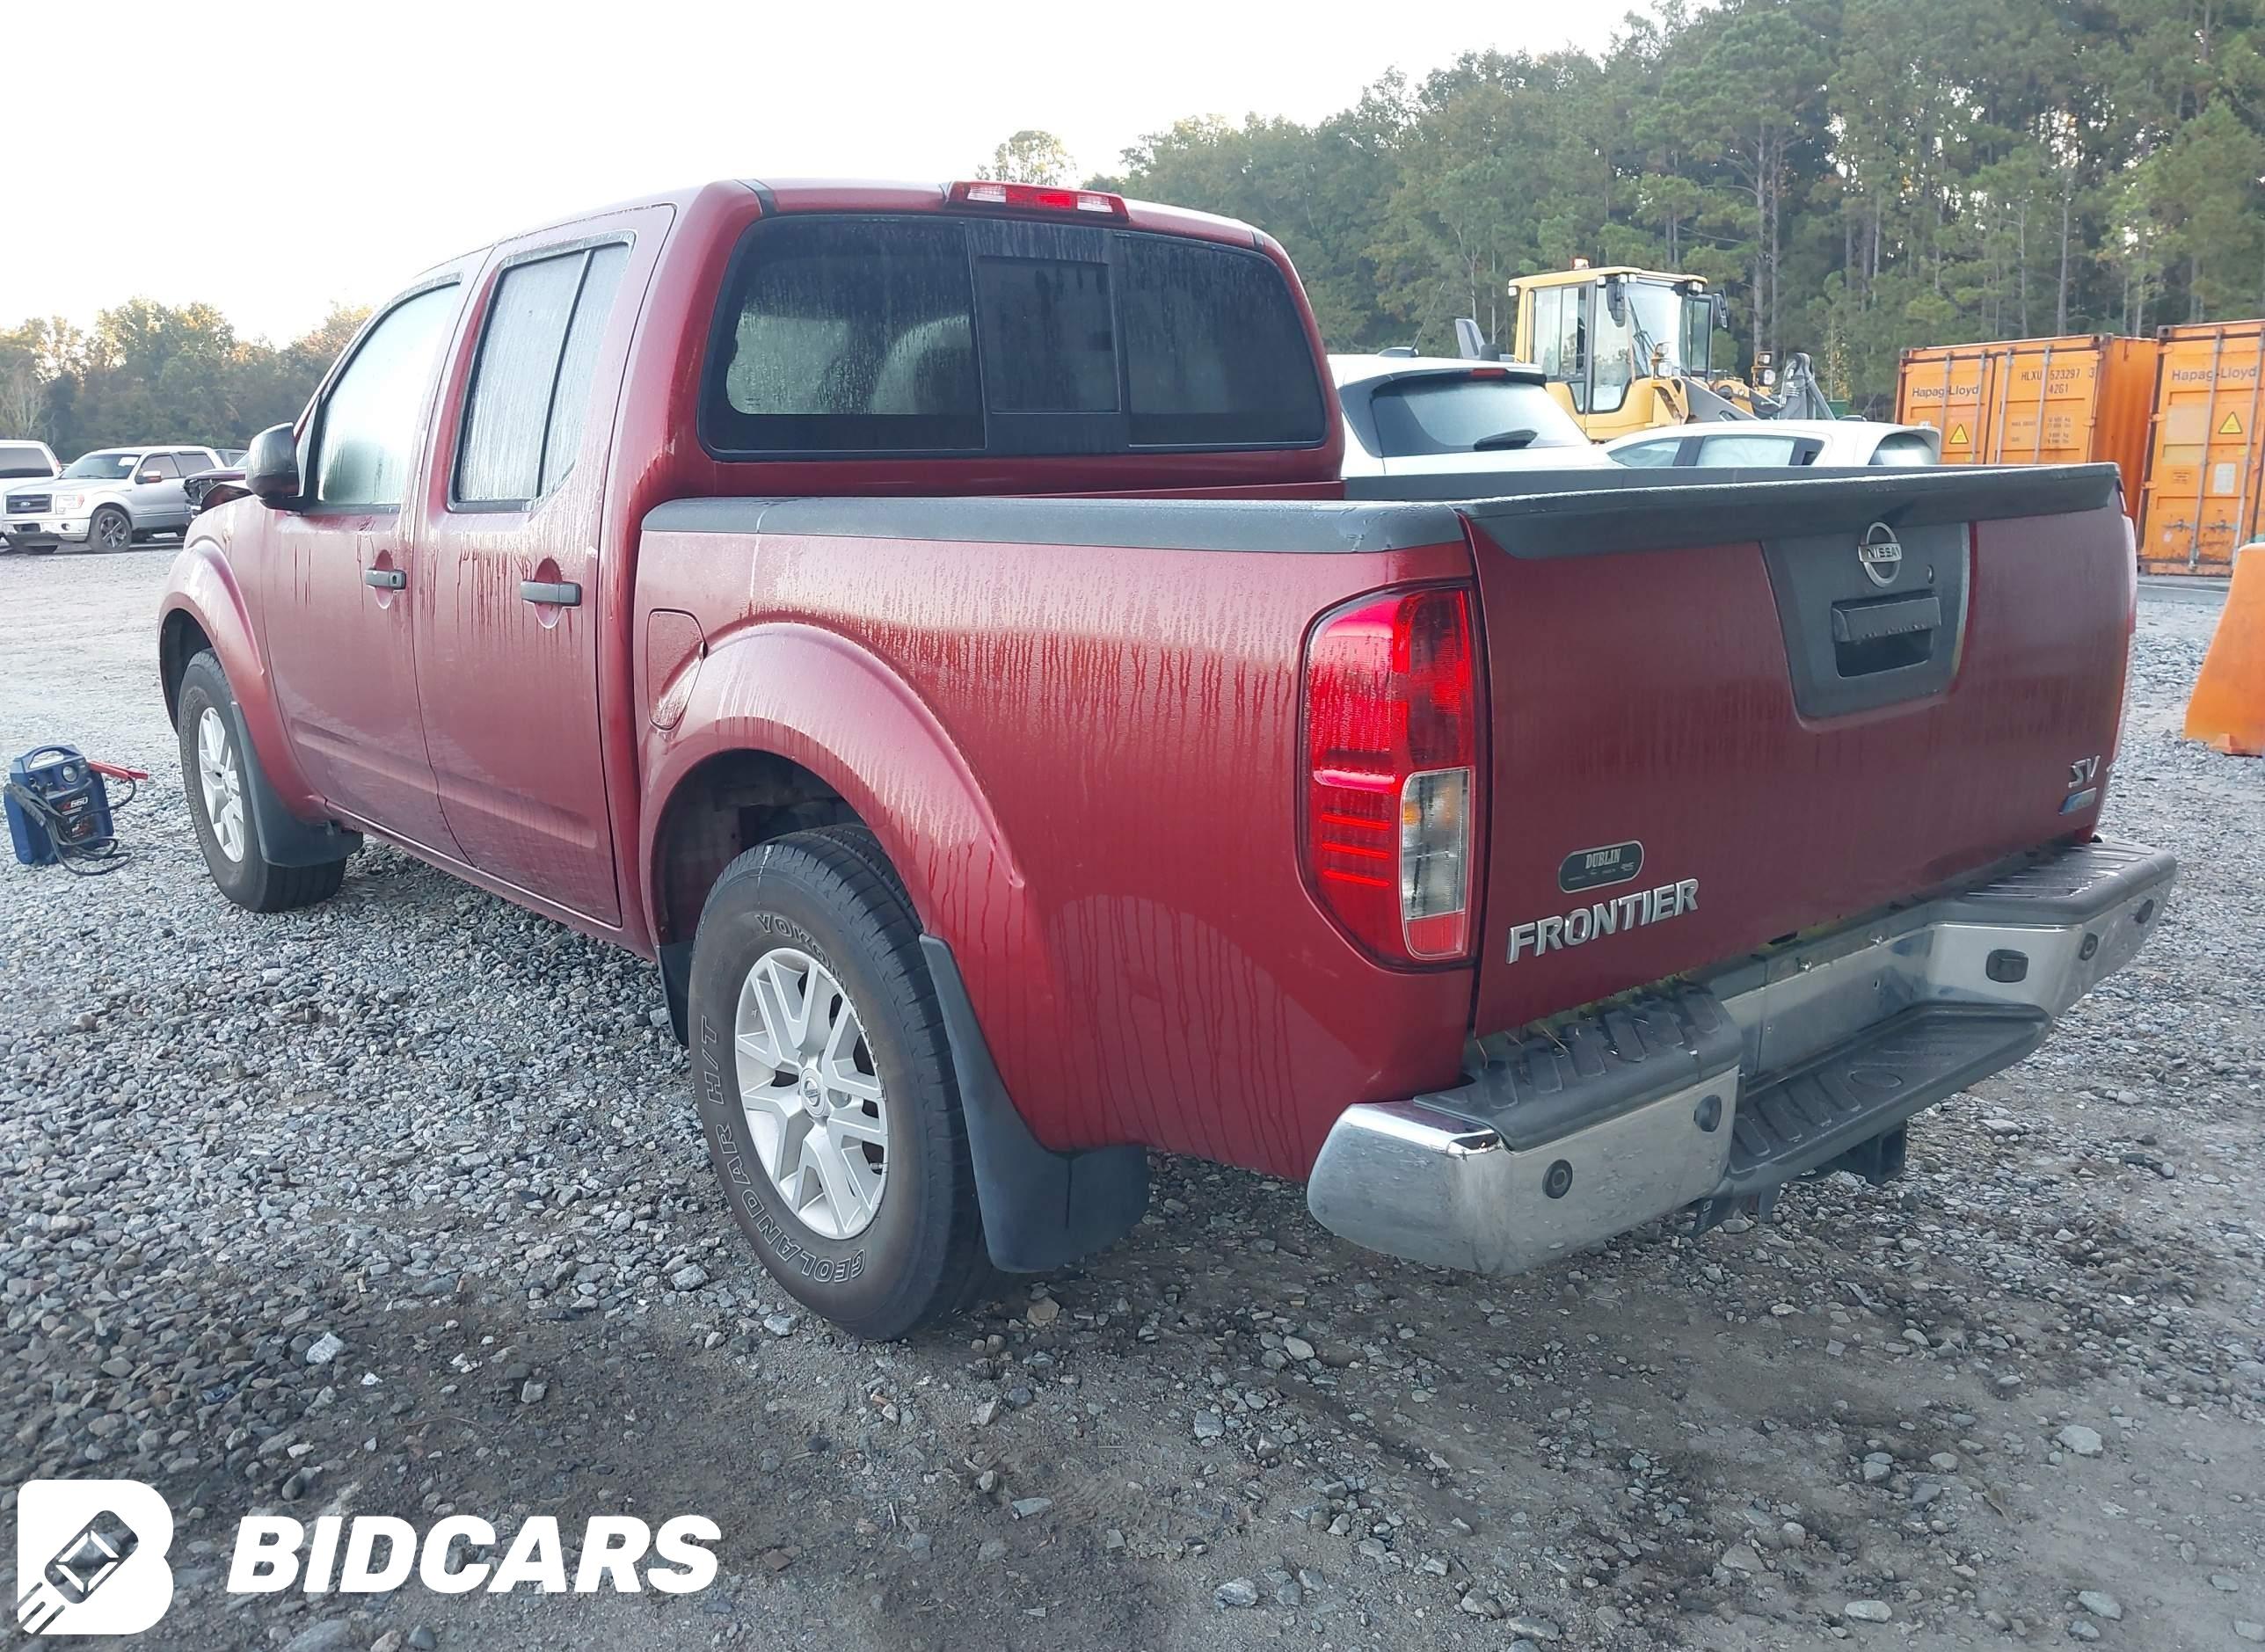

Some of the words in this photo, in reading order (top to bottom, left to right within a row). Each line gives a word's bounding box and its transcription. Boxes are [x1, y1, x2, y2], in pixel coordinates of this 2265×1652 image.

[1867, 546, 1900, 559] NISSAN
[2068, 755, 2101, 788] SV
[1584, 848, 1621, 870] DUBLIN
[1505, 878, 1699, 964] FRONTIER
[716, 1124, 866, 1283] GEOLANDAR
